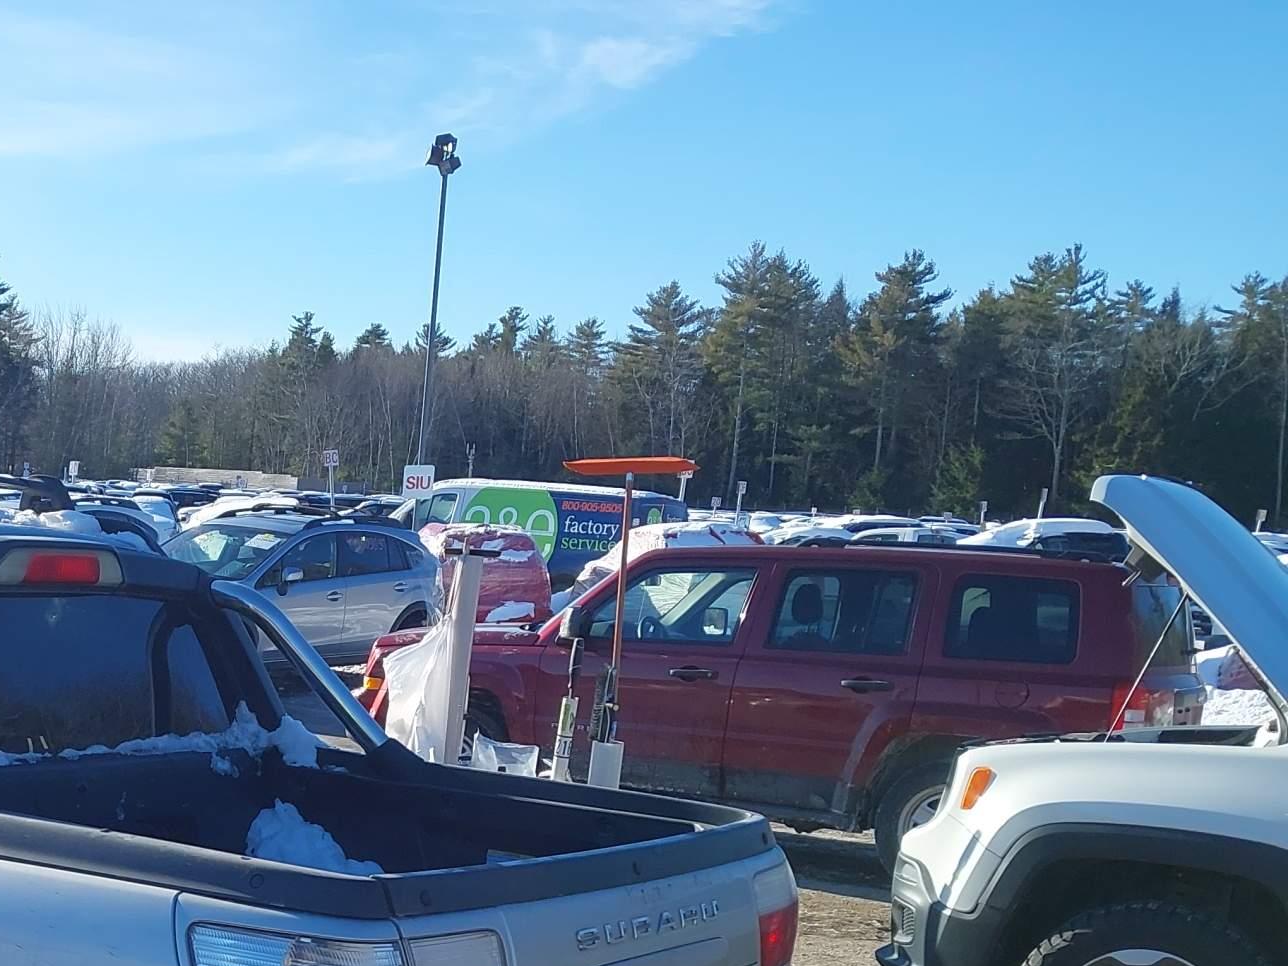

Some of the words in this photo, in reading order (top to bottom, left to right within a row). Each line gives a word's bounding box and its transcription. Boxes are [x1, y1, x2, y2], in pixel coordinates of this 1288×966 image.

[406, 475, 431, 490] SIU
[564, 515, 619, 541] factory
[575, 899, 720, 951] SUBARU
